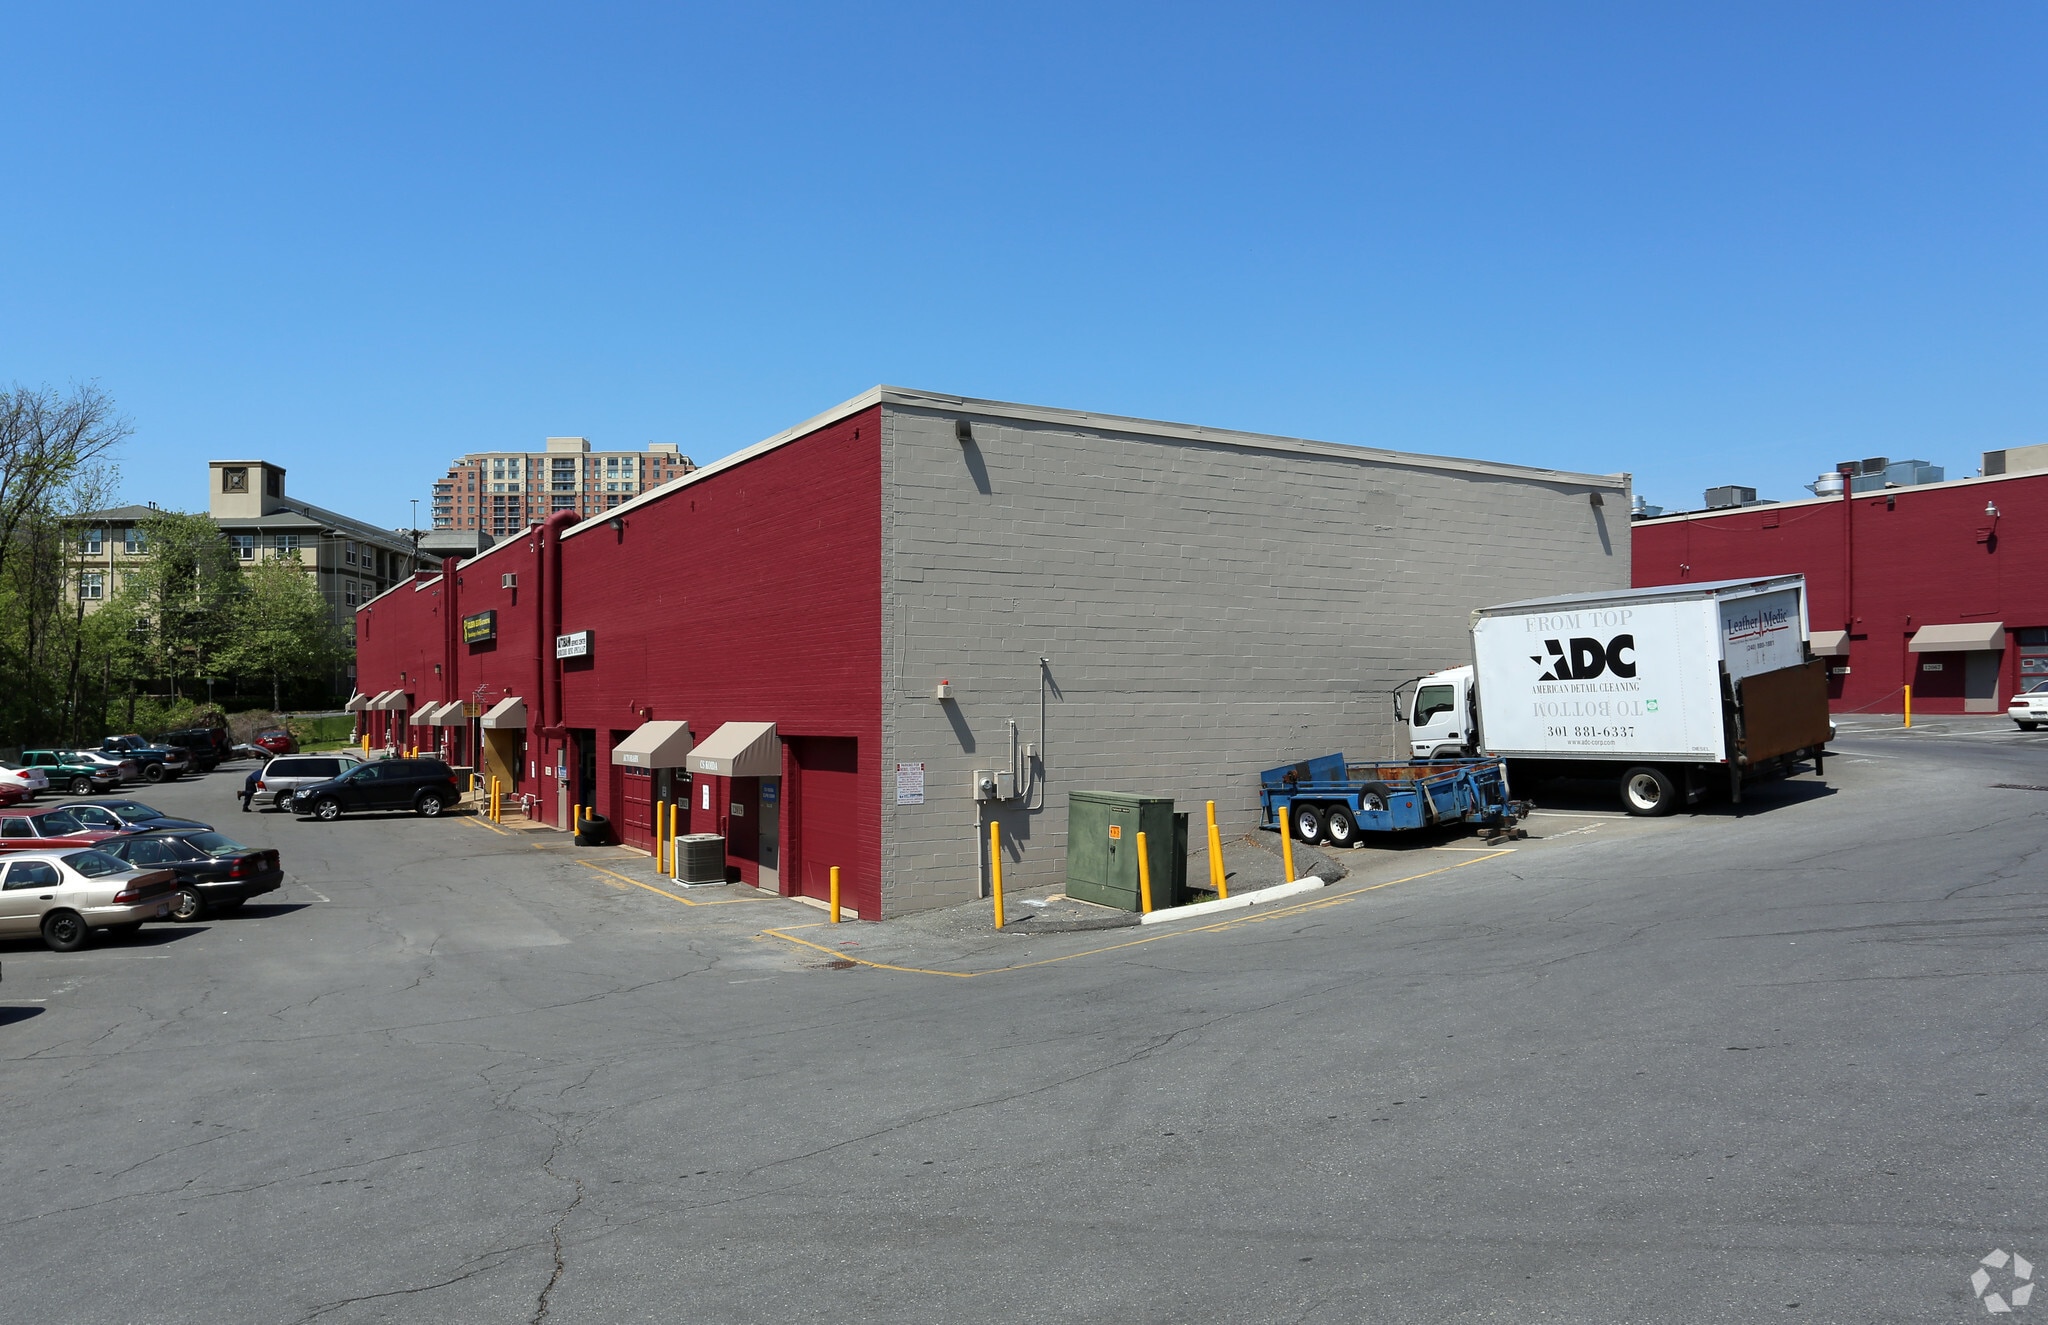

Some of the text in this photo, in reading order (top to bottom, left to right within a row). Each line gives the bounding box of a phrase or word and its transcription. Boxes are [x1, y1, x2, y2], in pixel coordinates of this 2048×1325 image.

[1525, 610, 1633, 632] FROM TOP
[1728, 608, 1787, 635] Leather Medic
[1529, 633, 1637, 681] ADC
[1532, 682, 1640, 695] AMERICAN DETAIL CLEANING
[1533, 700, 1643, 717] TO BOTTOM
[1547, 726, 1635, 738] 301 881-6337
[1567, 739, 1616, 747] www.adc-corp.com
